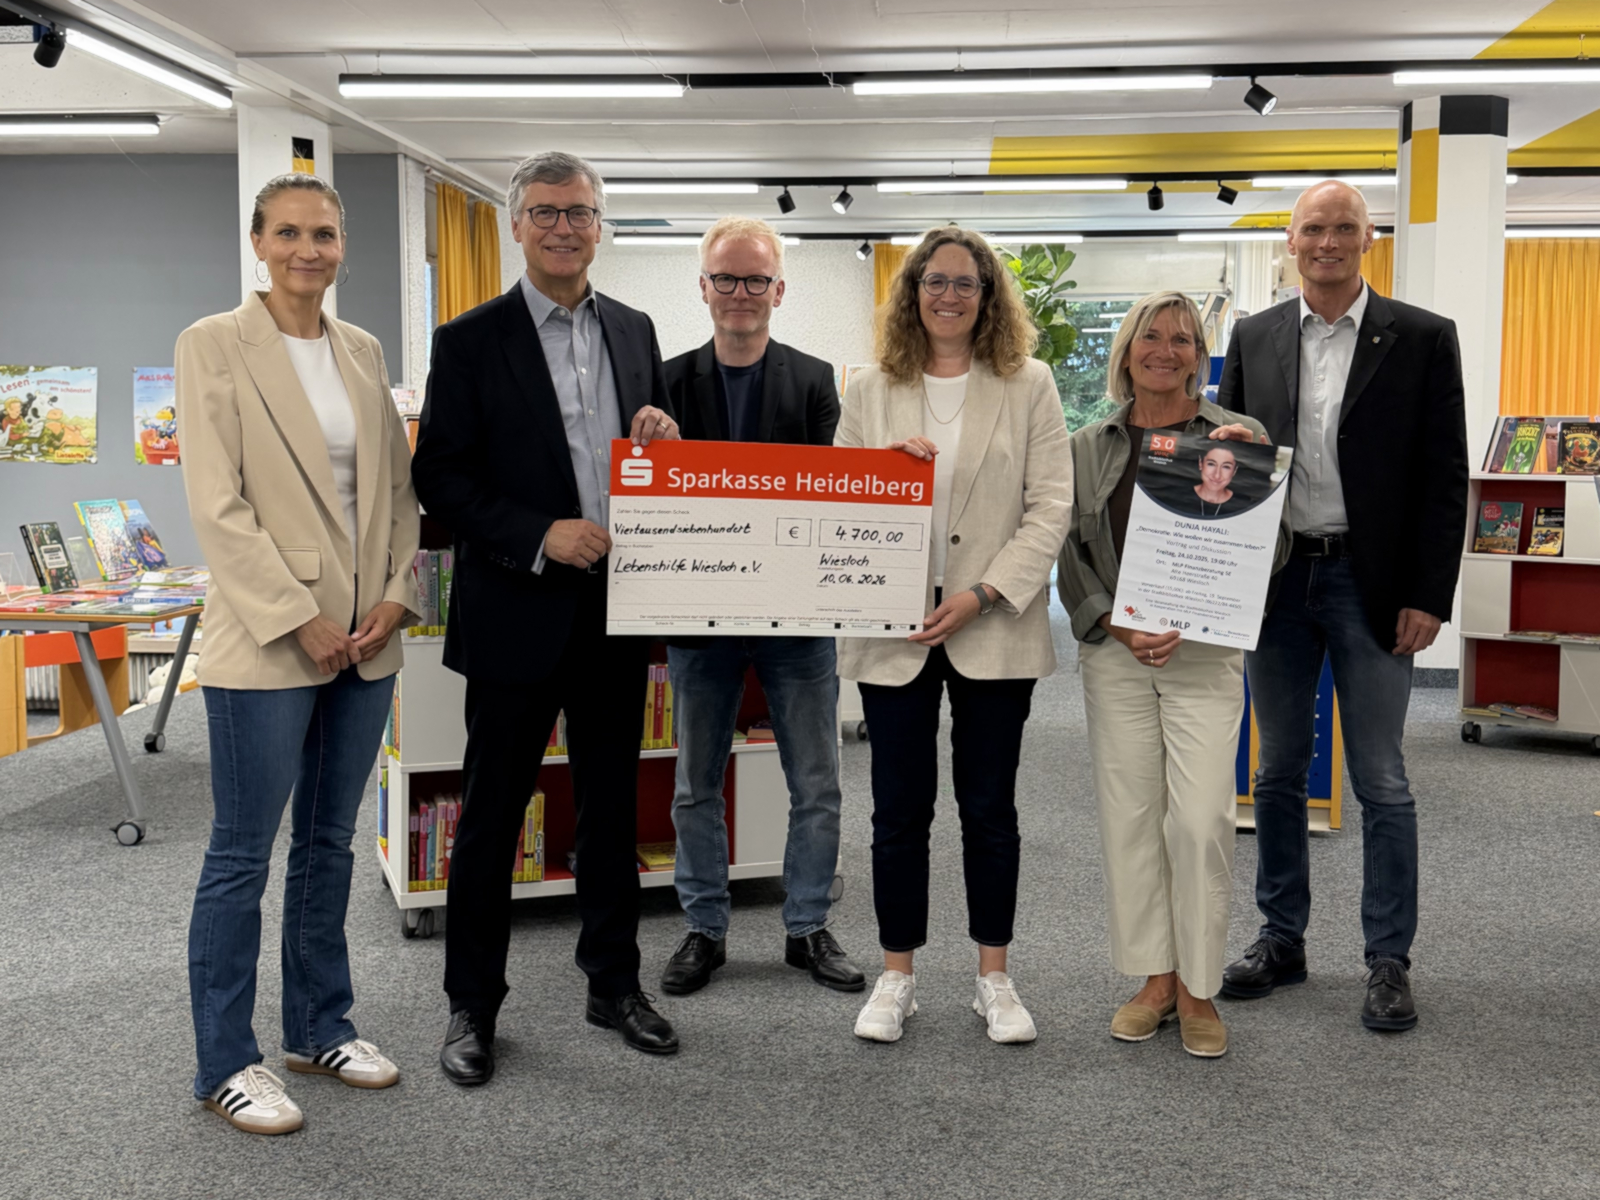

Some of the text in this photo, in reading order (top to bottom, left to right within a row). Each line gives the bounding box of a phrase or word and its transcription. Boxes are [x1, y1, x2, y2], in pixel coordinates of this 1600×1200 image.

[0, 379, 30, 394] Lesen
[667, 467, 924, 502] Sparkasse Heidelberg
[614, 522, 751, 535] Viertausendsiebenhundert
[788, 526, 799, 539] €
[836, 525, 904, 544] 4.700,00
[1174, 520, 1229, 536] DUNJA HAYALI:
[1156, 548, 1176, 558] Freitag,
[1166, 540, 1187, 549] Vortrag
[1201, 545, 1232, 555] Diskussion
[614, 557, 687, 573] Lebenshilfe
[691, 559, 737, 573] Wiesloch
[819, 553, 869, 566] Wiesloch
[1170, 619, 1190, 630] MLP
